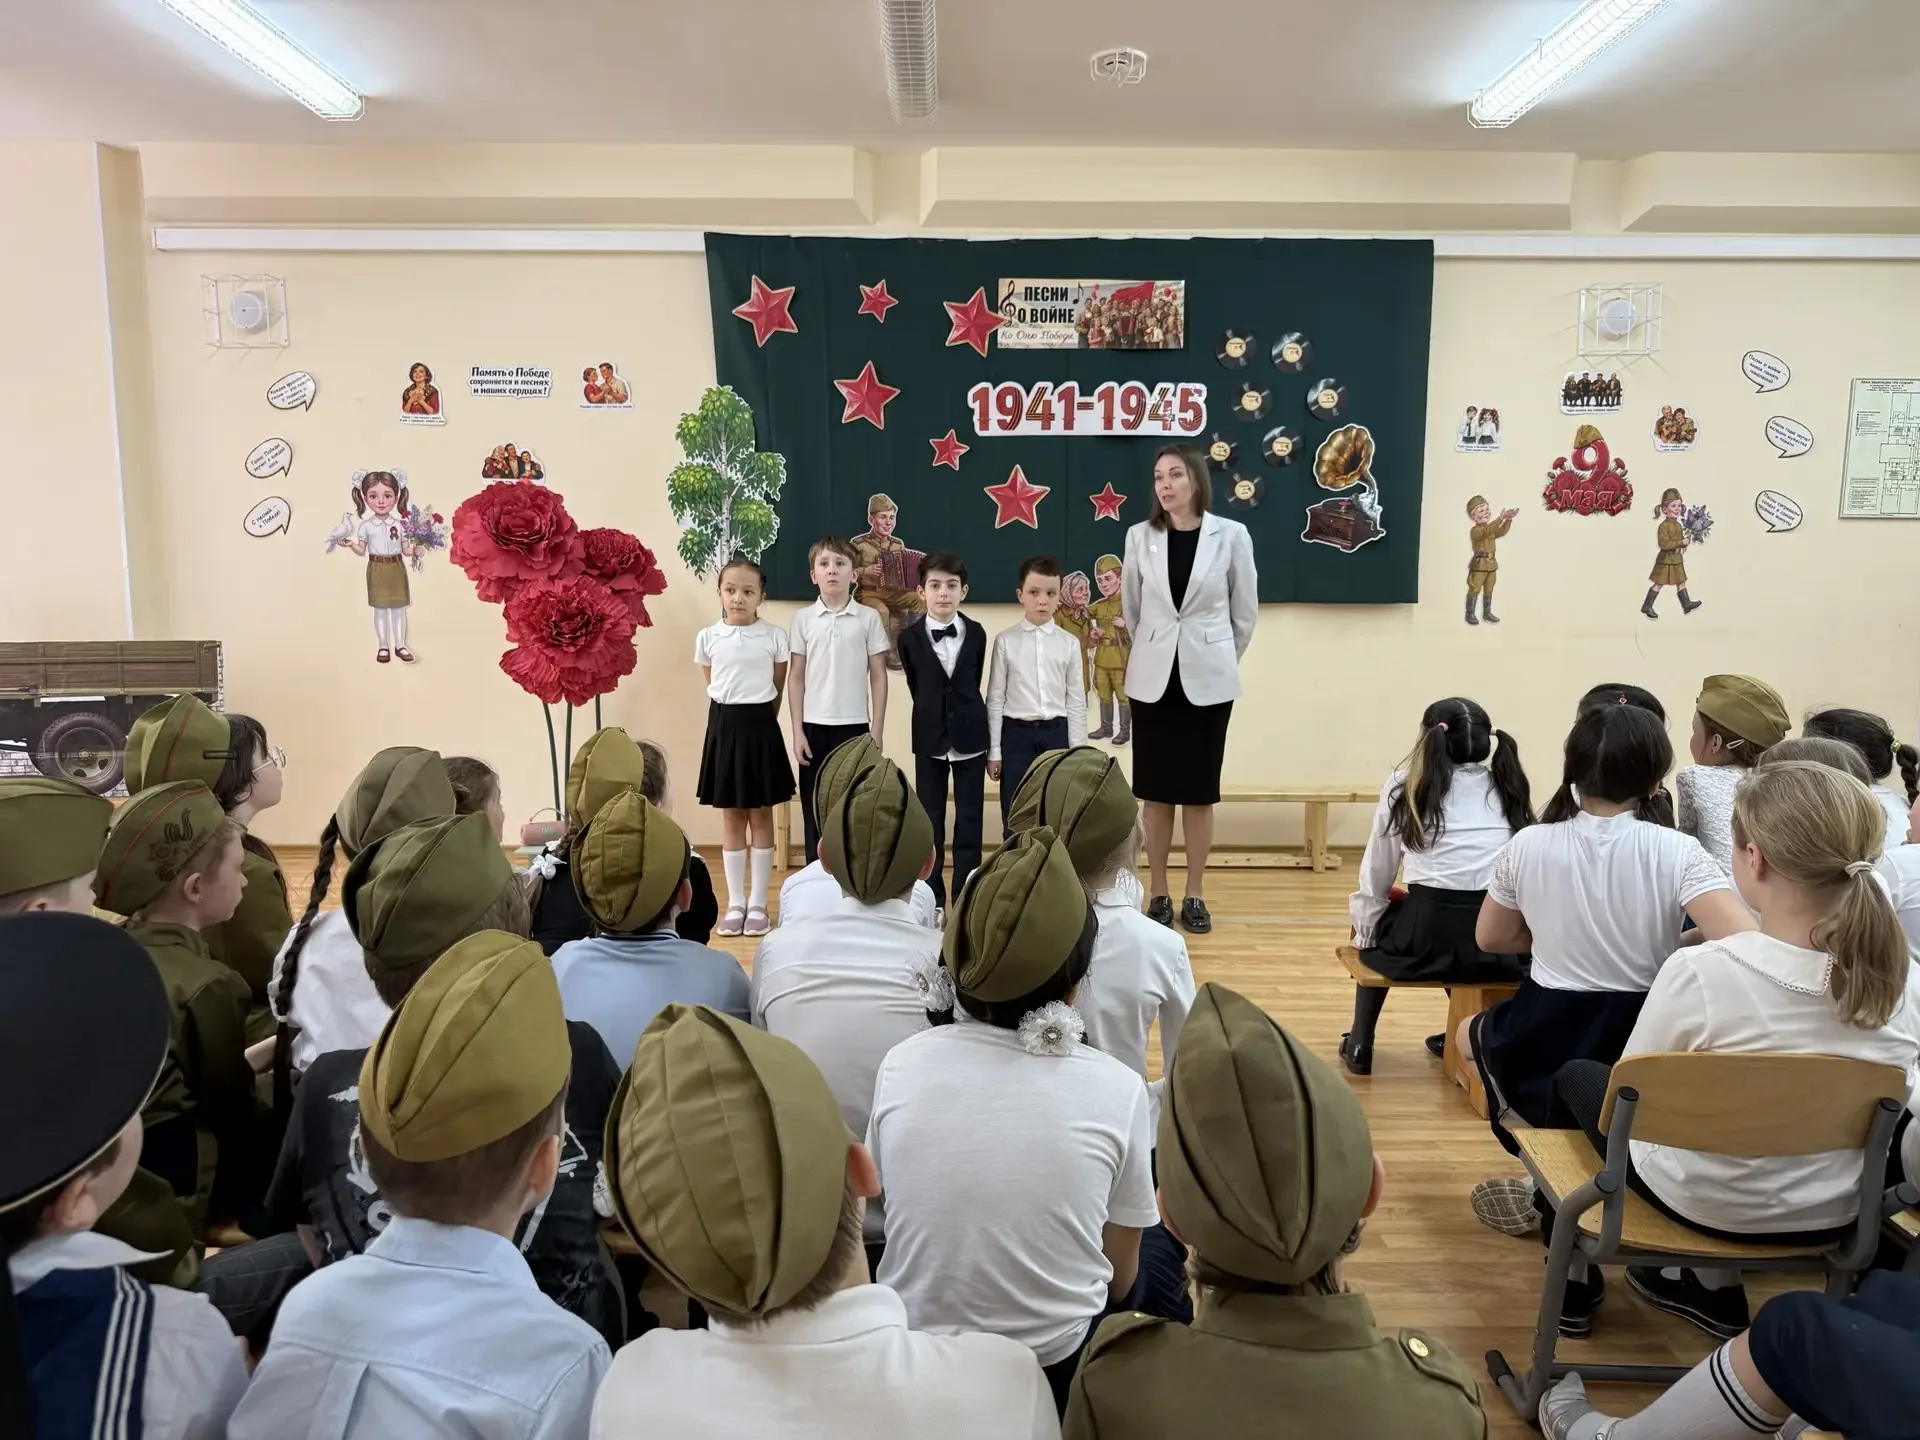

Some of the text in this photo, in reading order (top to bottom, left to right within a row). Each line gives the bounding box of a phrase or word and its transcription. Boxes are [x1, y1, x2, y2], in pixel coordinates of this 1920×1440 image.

[1024, 286, 1069, 302] ПЕСНИ
[1018, 305, 1074, 323] О ВОЙНЕ
[1000, 330, 1014, 340] Ко
[1016, 330, 1038, 340] Дню
[472, 367, 507, 377] Память
[516, 367, 550, 378] Победе
[508, 387, 547, 396] сердцах!
[972, 386, 1203, 431] 1941-1945
[1572, 439, 1610, 487] 9
[1560, 489, 1614, 509] мая
